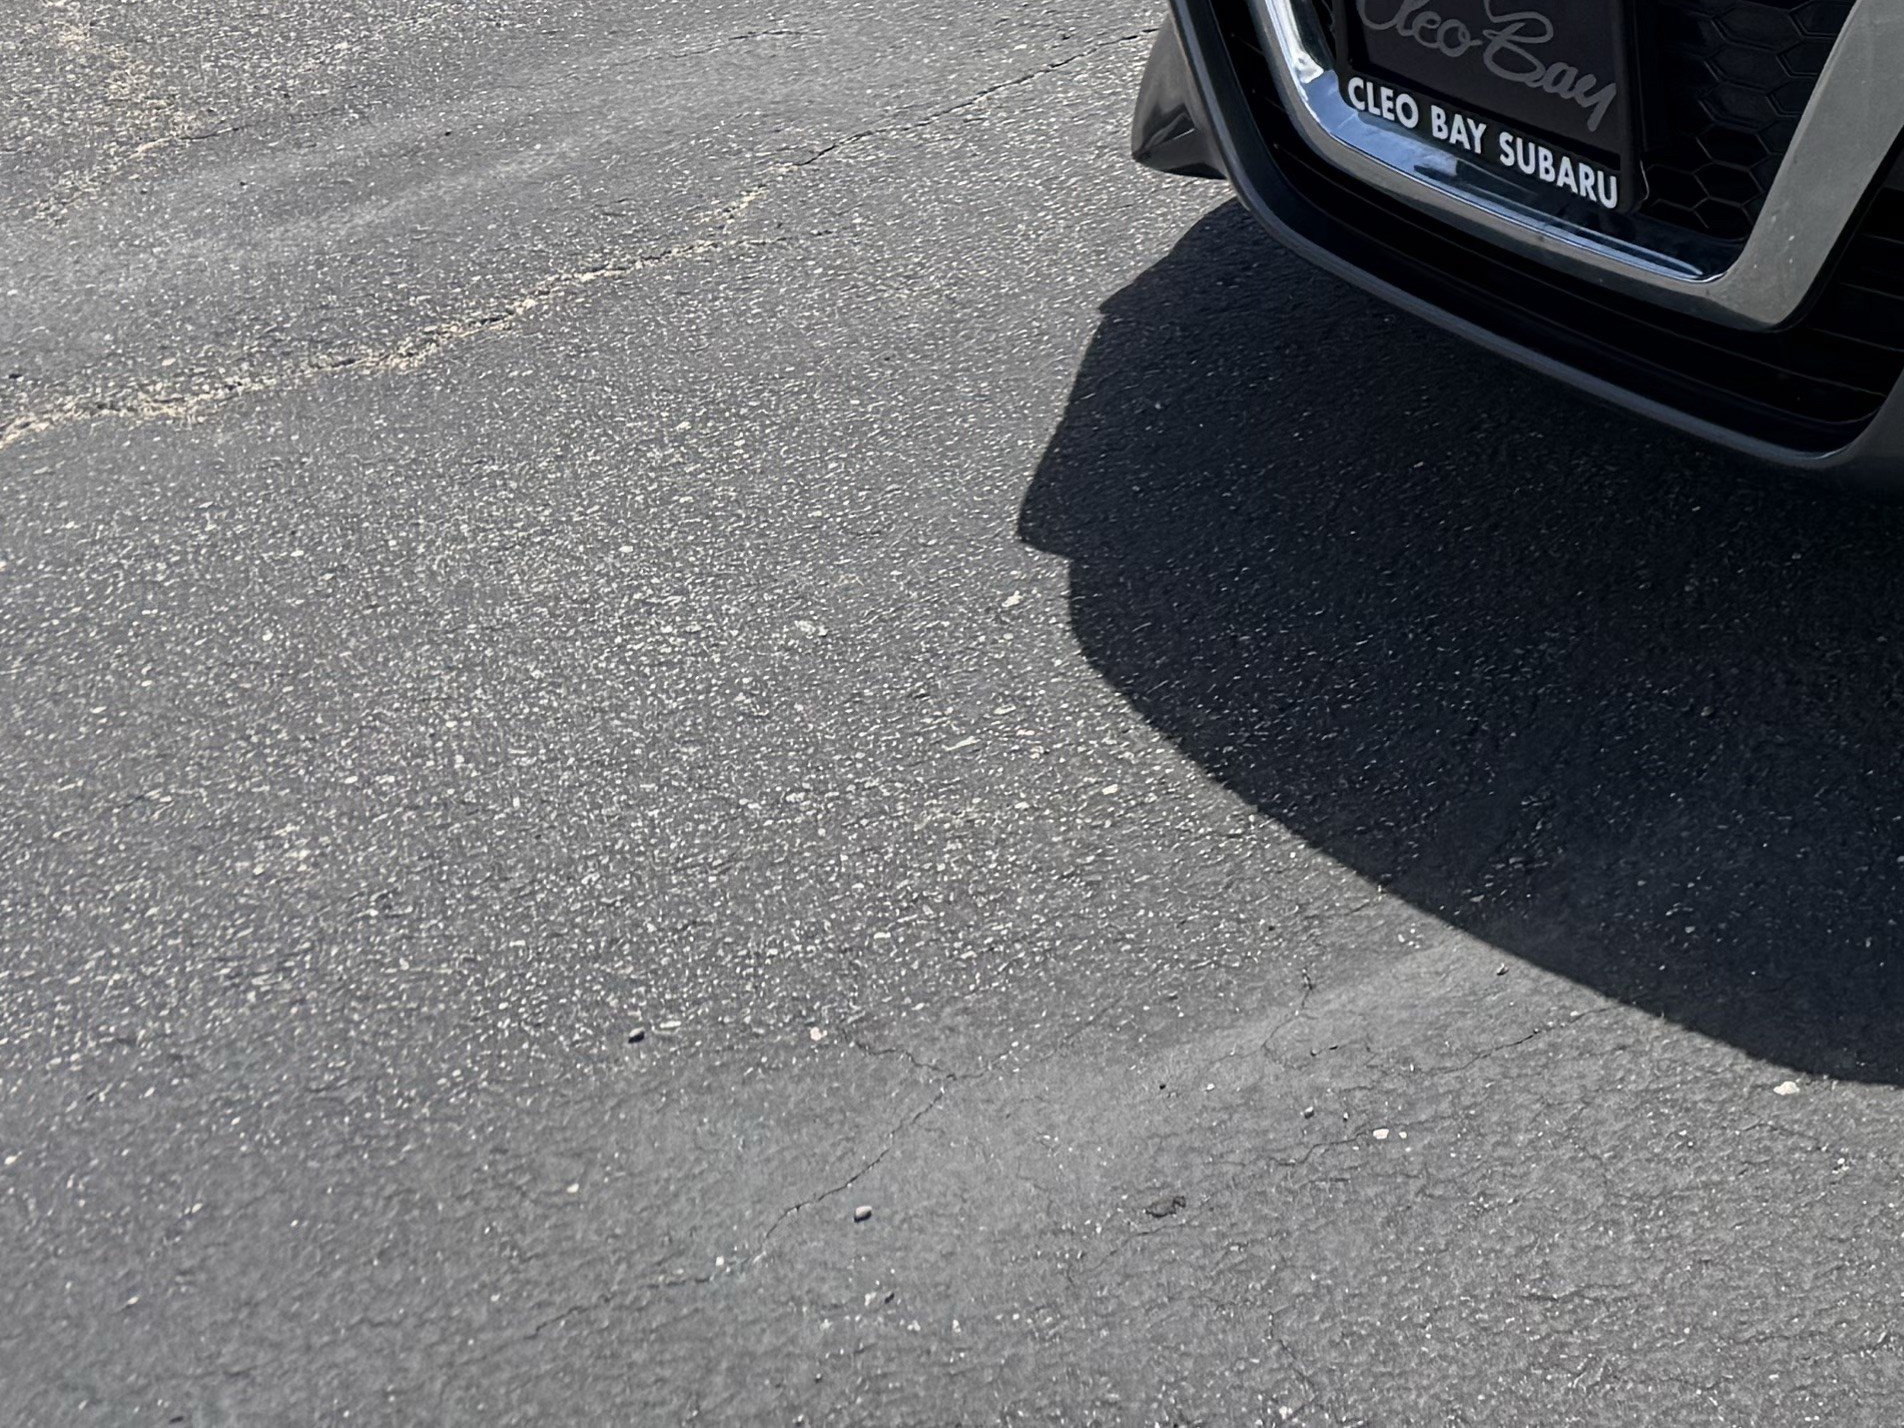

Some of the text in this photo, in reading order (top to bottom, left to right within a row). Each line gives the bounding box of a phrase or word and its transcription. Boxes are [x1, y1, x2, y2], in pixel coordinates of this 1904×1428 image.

[1348, 77, 1619, 209] CLEO BAY SUBARU
